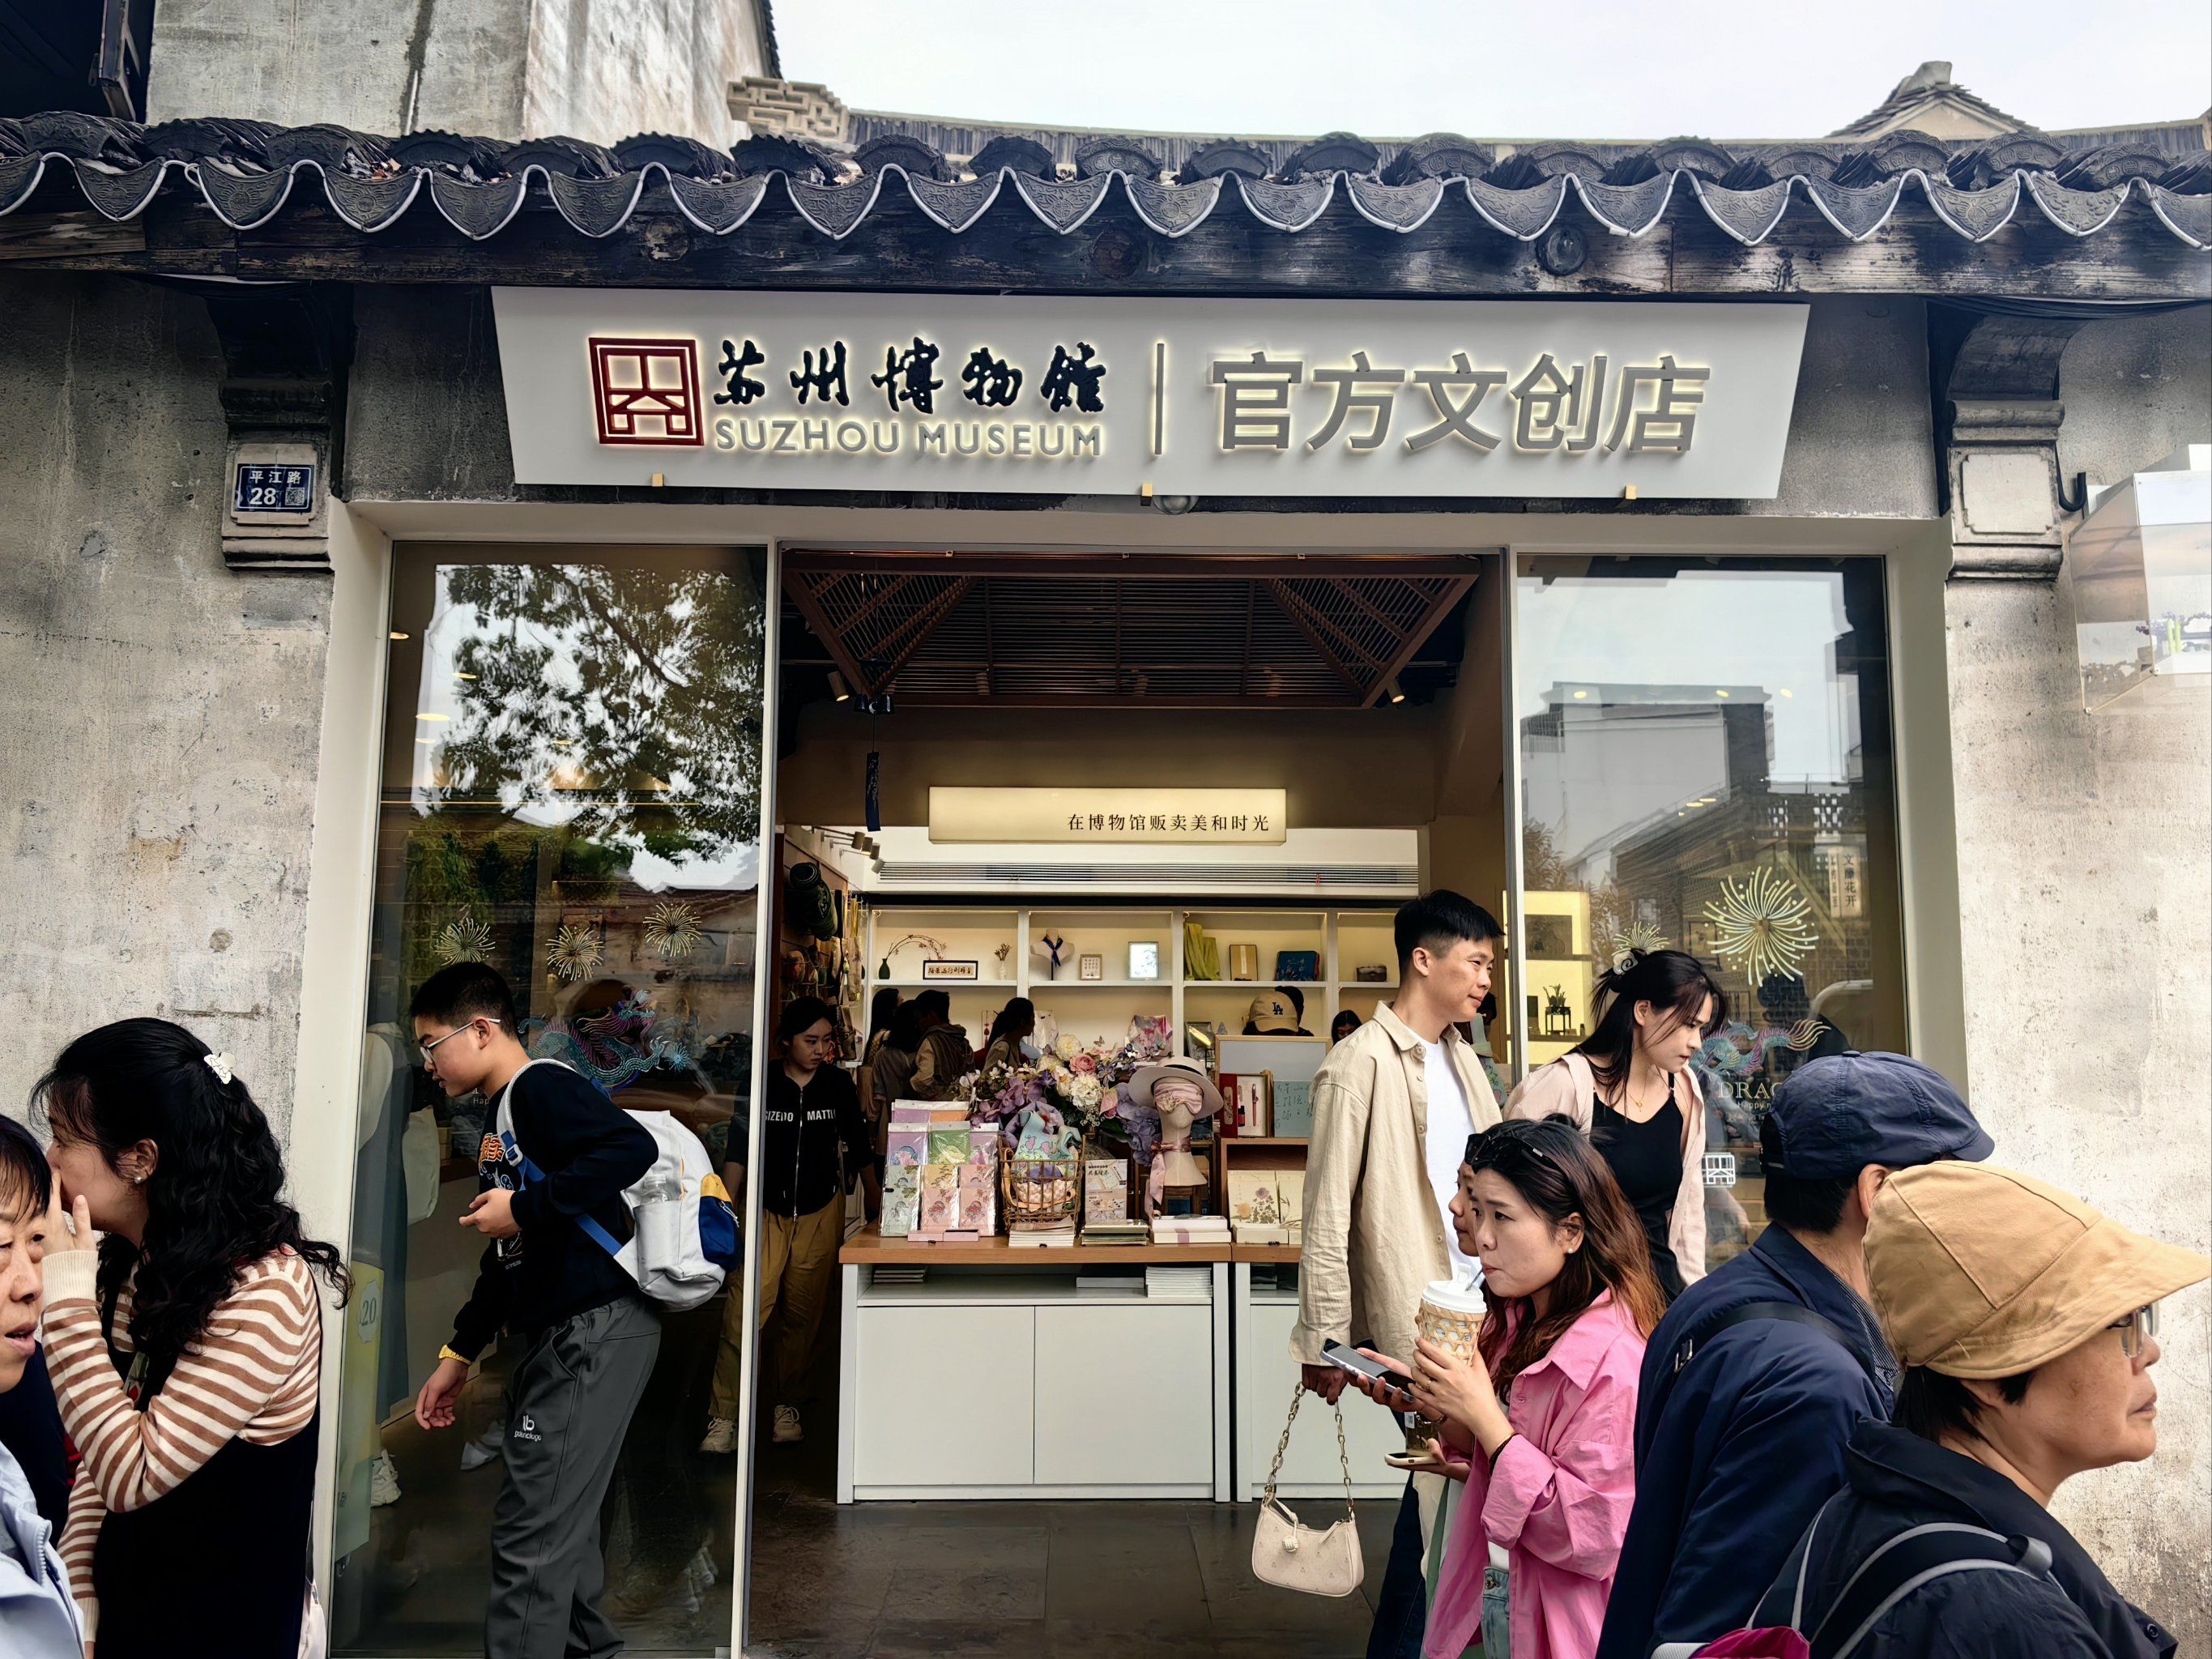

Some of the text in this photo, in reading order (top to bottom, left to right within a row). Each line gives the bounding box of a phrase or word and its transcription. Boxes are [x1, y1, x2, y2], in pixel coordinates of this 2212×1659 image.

[714, 335, 1107, 416] 苏州博物馆
[1211, 350, 1710, 452] 官方文创店
[714, 418, 1102, 457] SUZHOU MUSEUM
[249, 470, 301, 484] 平江路
[249, 487, 277, 505] 28
[1067, 812, 1270, 833] 在博物馆贩卖美和时光
[1272, 1002, 1283, 1014] LA
[1737, 1102, 1764, 1111] Happy
